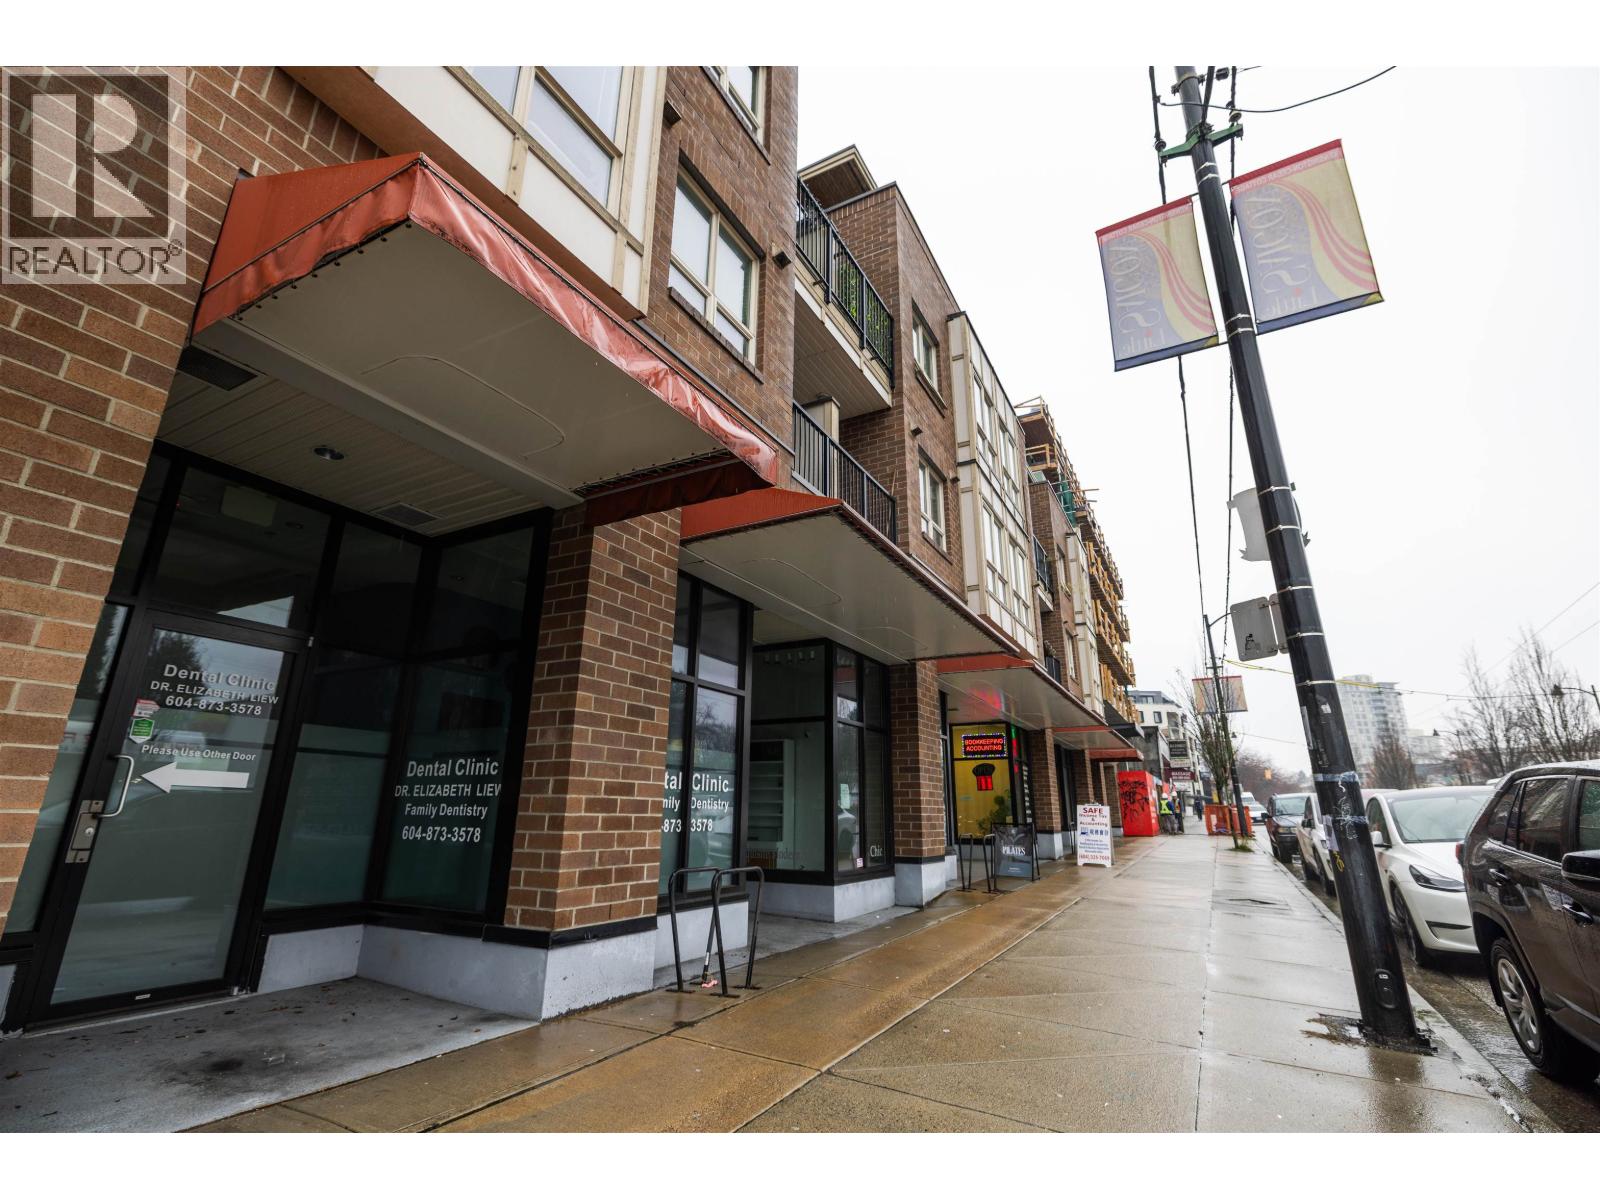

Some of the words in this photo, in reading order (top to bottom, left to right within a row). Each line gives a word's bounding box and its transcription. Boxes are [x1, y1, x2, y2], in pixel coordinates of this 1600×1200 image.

[163, 664, 223, 685] Dental
[226, 673, 276, 691] Clinic
[150, 680, 173, 693] DR.
[176, 684, 246, 700] ELIZABETH
[250, 694, 279, 705] LIEW
[165, 695, 262, 716] 604-873-3578
[141, 744, 178, 756] Please
[180, 747, 200, 758] Use
[202, 749, 231, 760] Other
[232, 751, 257, 761] Door
[966, 744, 1002, 752] ACCOUNTING
[406, 759, 452, 777] Dental
[455, 757, 499, 776] Clinic
[394, 785, 411, 797] DR.
[413, 784, 472, 797] ELIZABETH
[692, 773, 729, 792] Clinic
[404, 803, 438, 819] Family
[439, 803, 488, 820] Dentistry
[691, 796, 729, 813] Dentistry
[690, 818, 713, 832] 3578
[402, 825, 481, 843] 604-873-3578
[869, 844, 882, 858] Chic
[1002, 846, 1026, 856] PILATES
